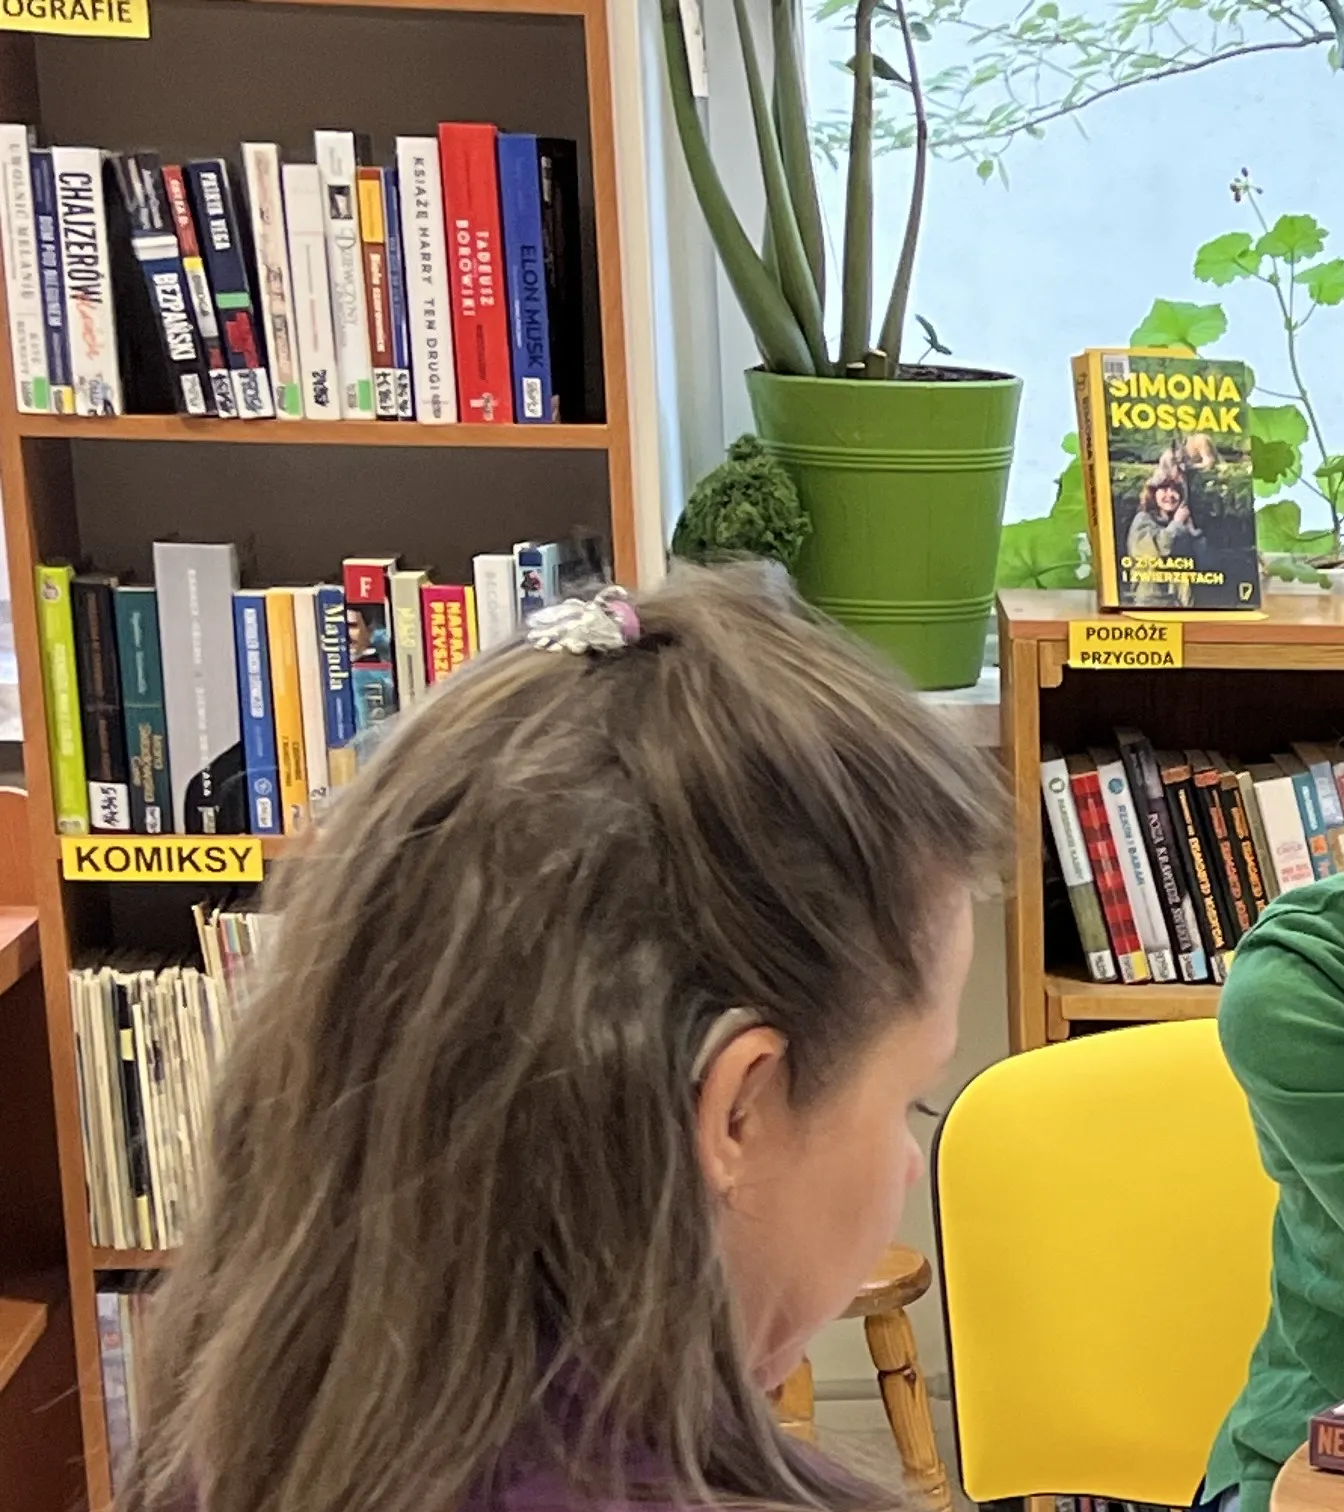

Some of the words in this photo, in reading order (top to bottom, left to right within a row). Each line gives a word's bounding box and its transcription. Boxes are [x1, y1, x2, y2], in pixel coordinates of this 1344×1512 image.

[3, 0, 133, 24] OGRAFIE
[58, 172, 103, 304] CHAJZERÓW
[520, 244, 538, 301] ELON
[153, 272, 197, 361] BEZPAŃSKI
[525, 308, 545, 369] MUSK
[1109, 372, 1242, 403] SIMONA
[1110, 402, 1243, 433] KOSSAK
[320, 603, 349, 690] Majjada
[1085, 625, 1168, 641] PODRÓŻE
[1081, 651, 1175, 666] PRZYGODA
[75, 845, 252, 874] KOMIKSY
